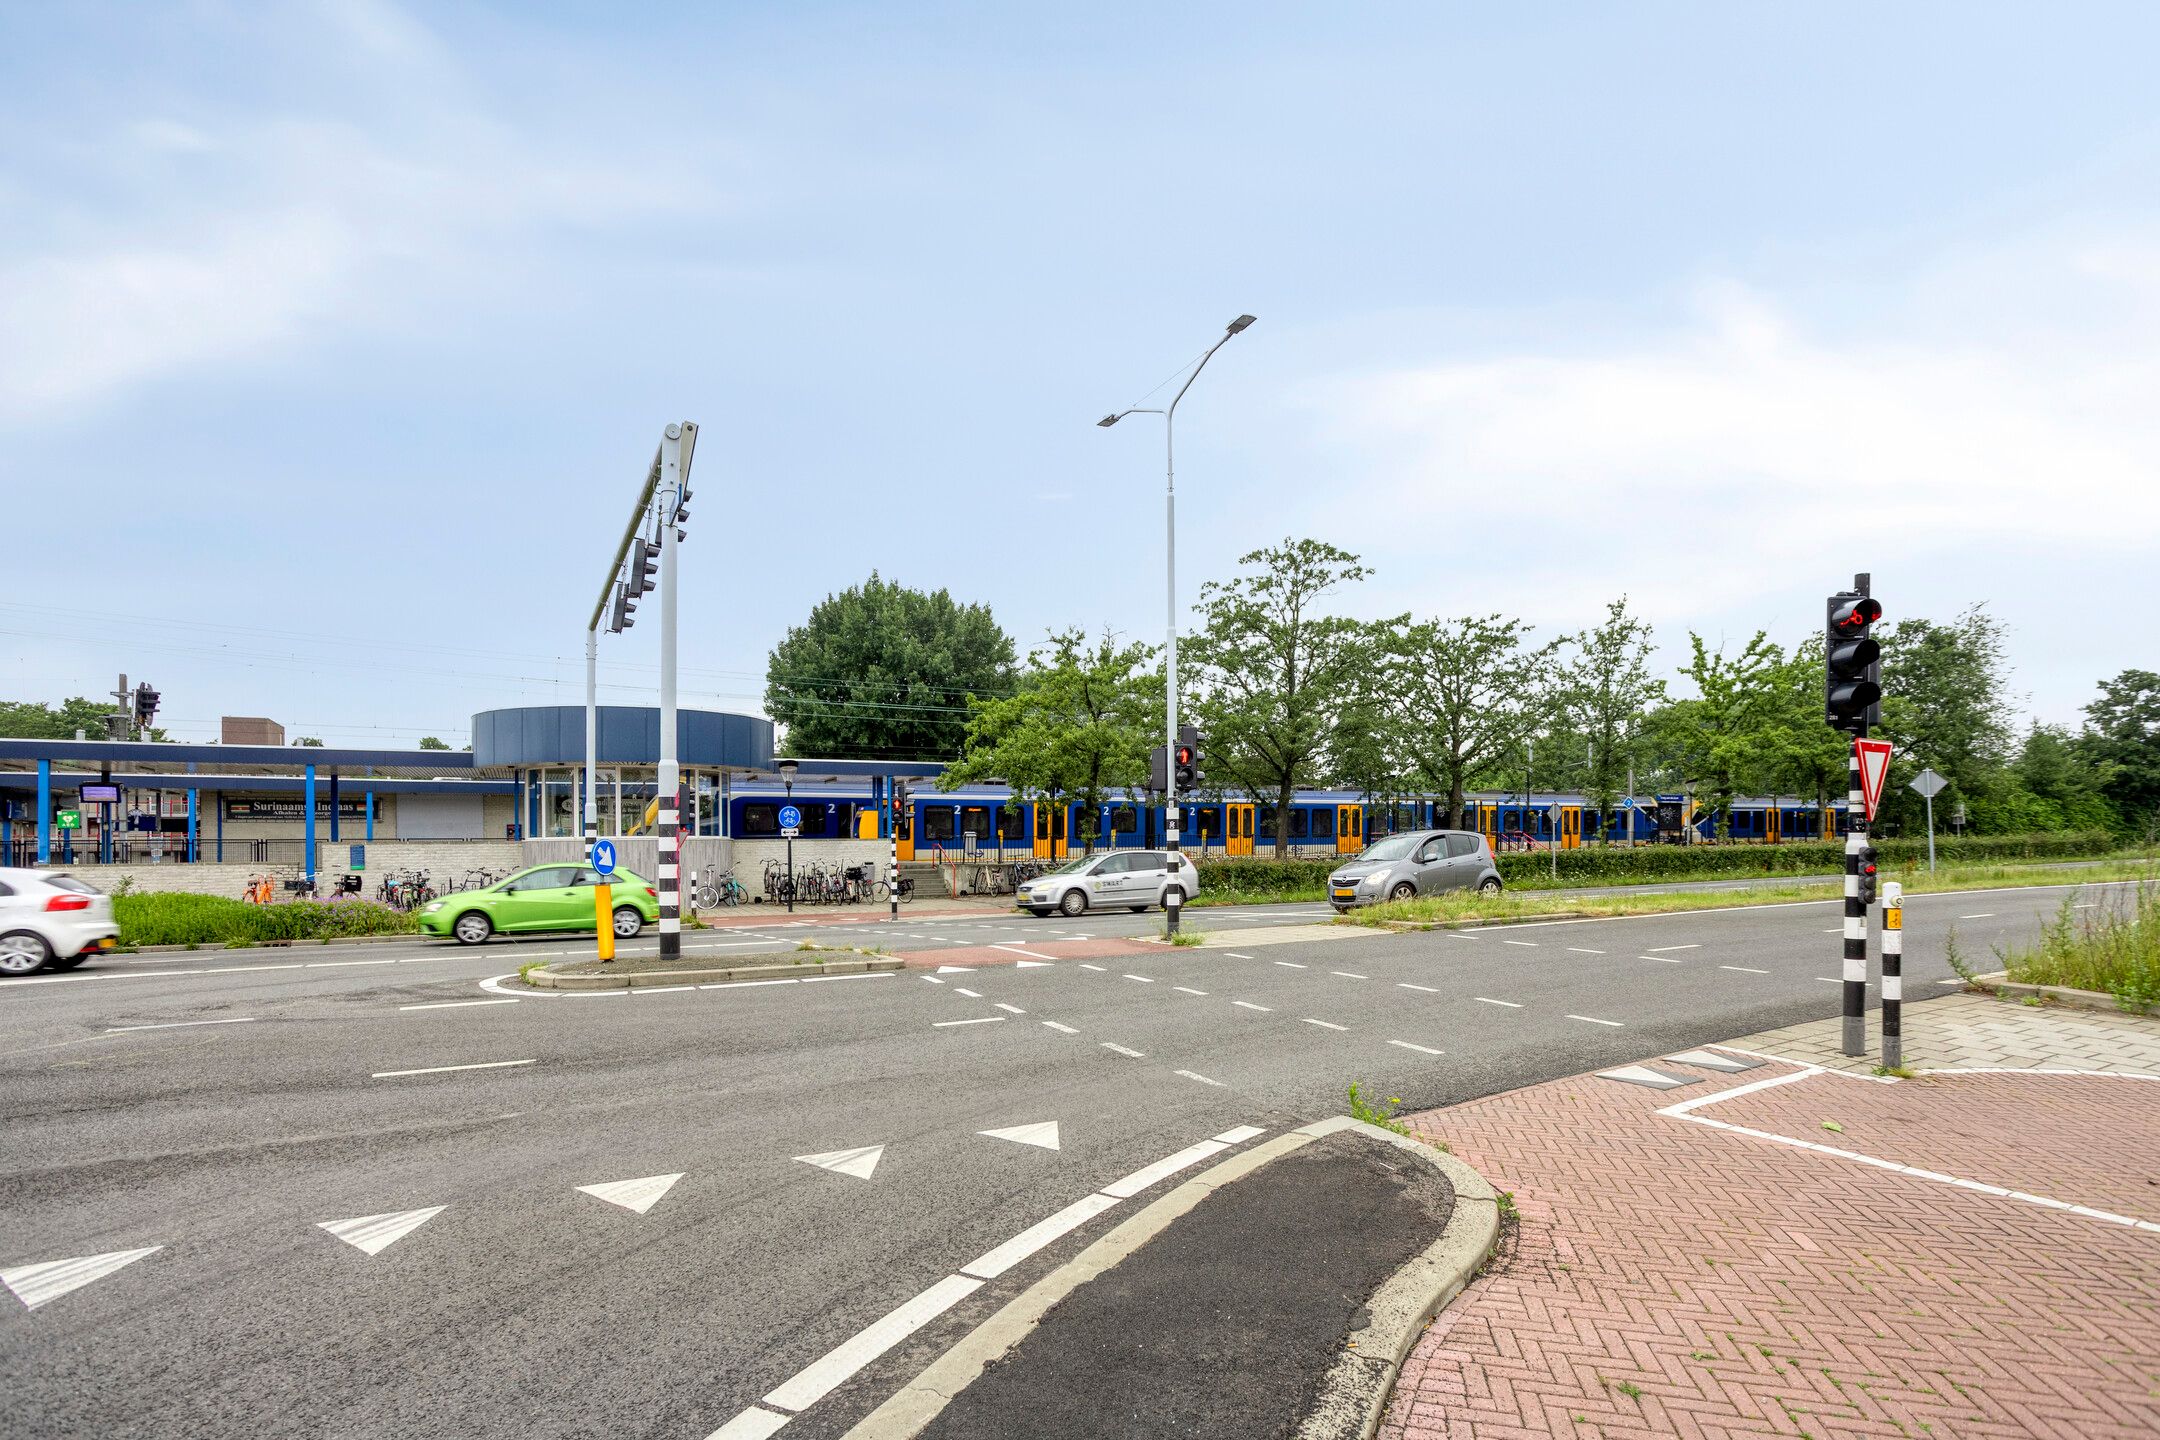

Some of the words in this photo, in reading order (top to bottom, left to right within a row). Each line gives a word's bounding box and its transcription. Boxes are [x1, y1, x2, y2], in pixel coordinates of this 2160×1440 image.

[317, 802, 353, 811] Inaas
[828, 804, 836, 813] 2
[954, 805, 961, 814] 2
[1103, 807, 1109, 815] 2
[1190, 807, 1196, 816] 2
